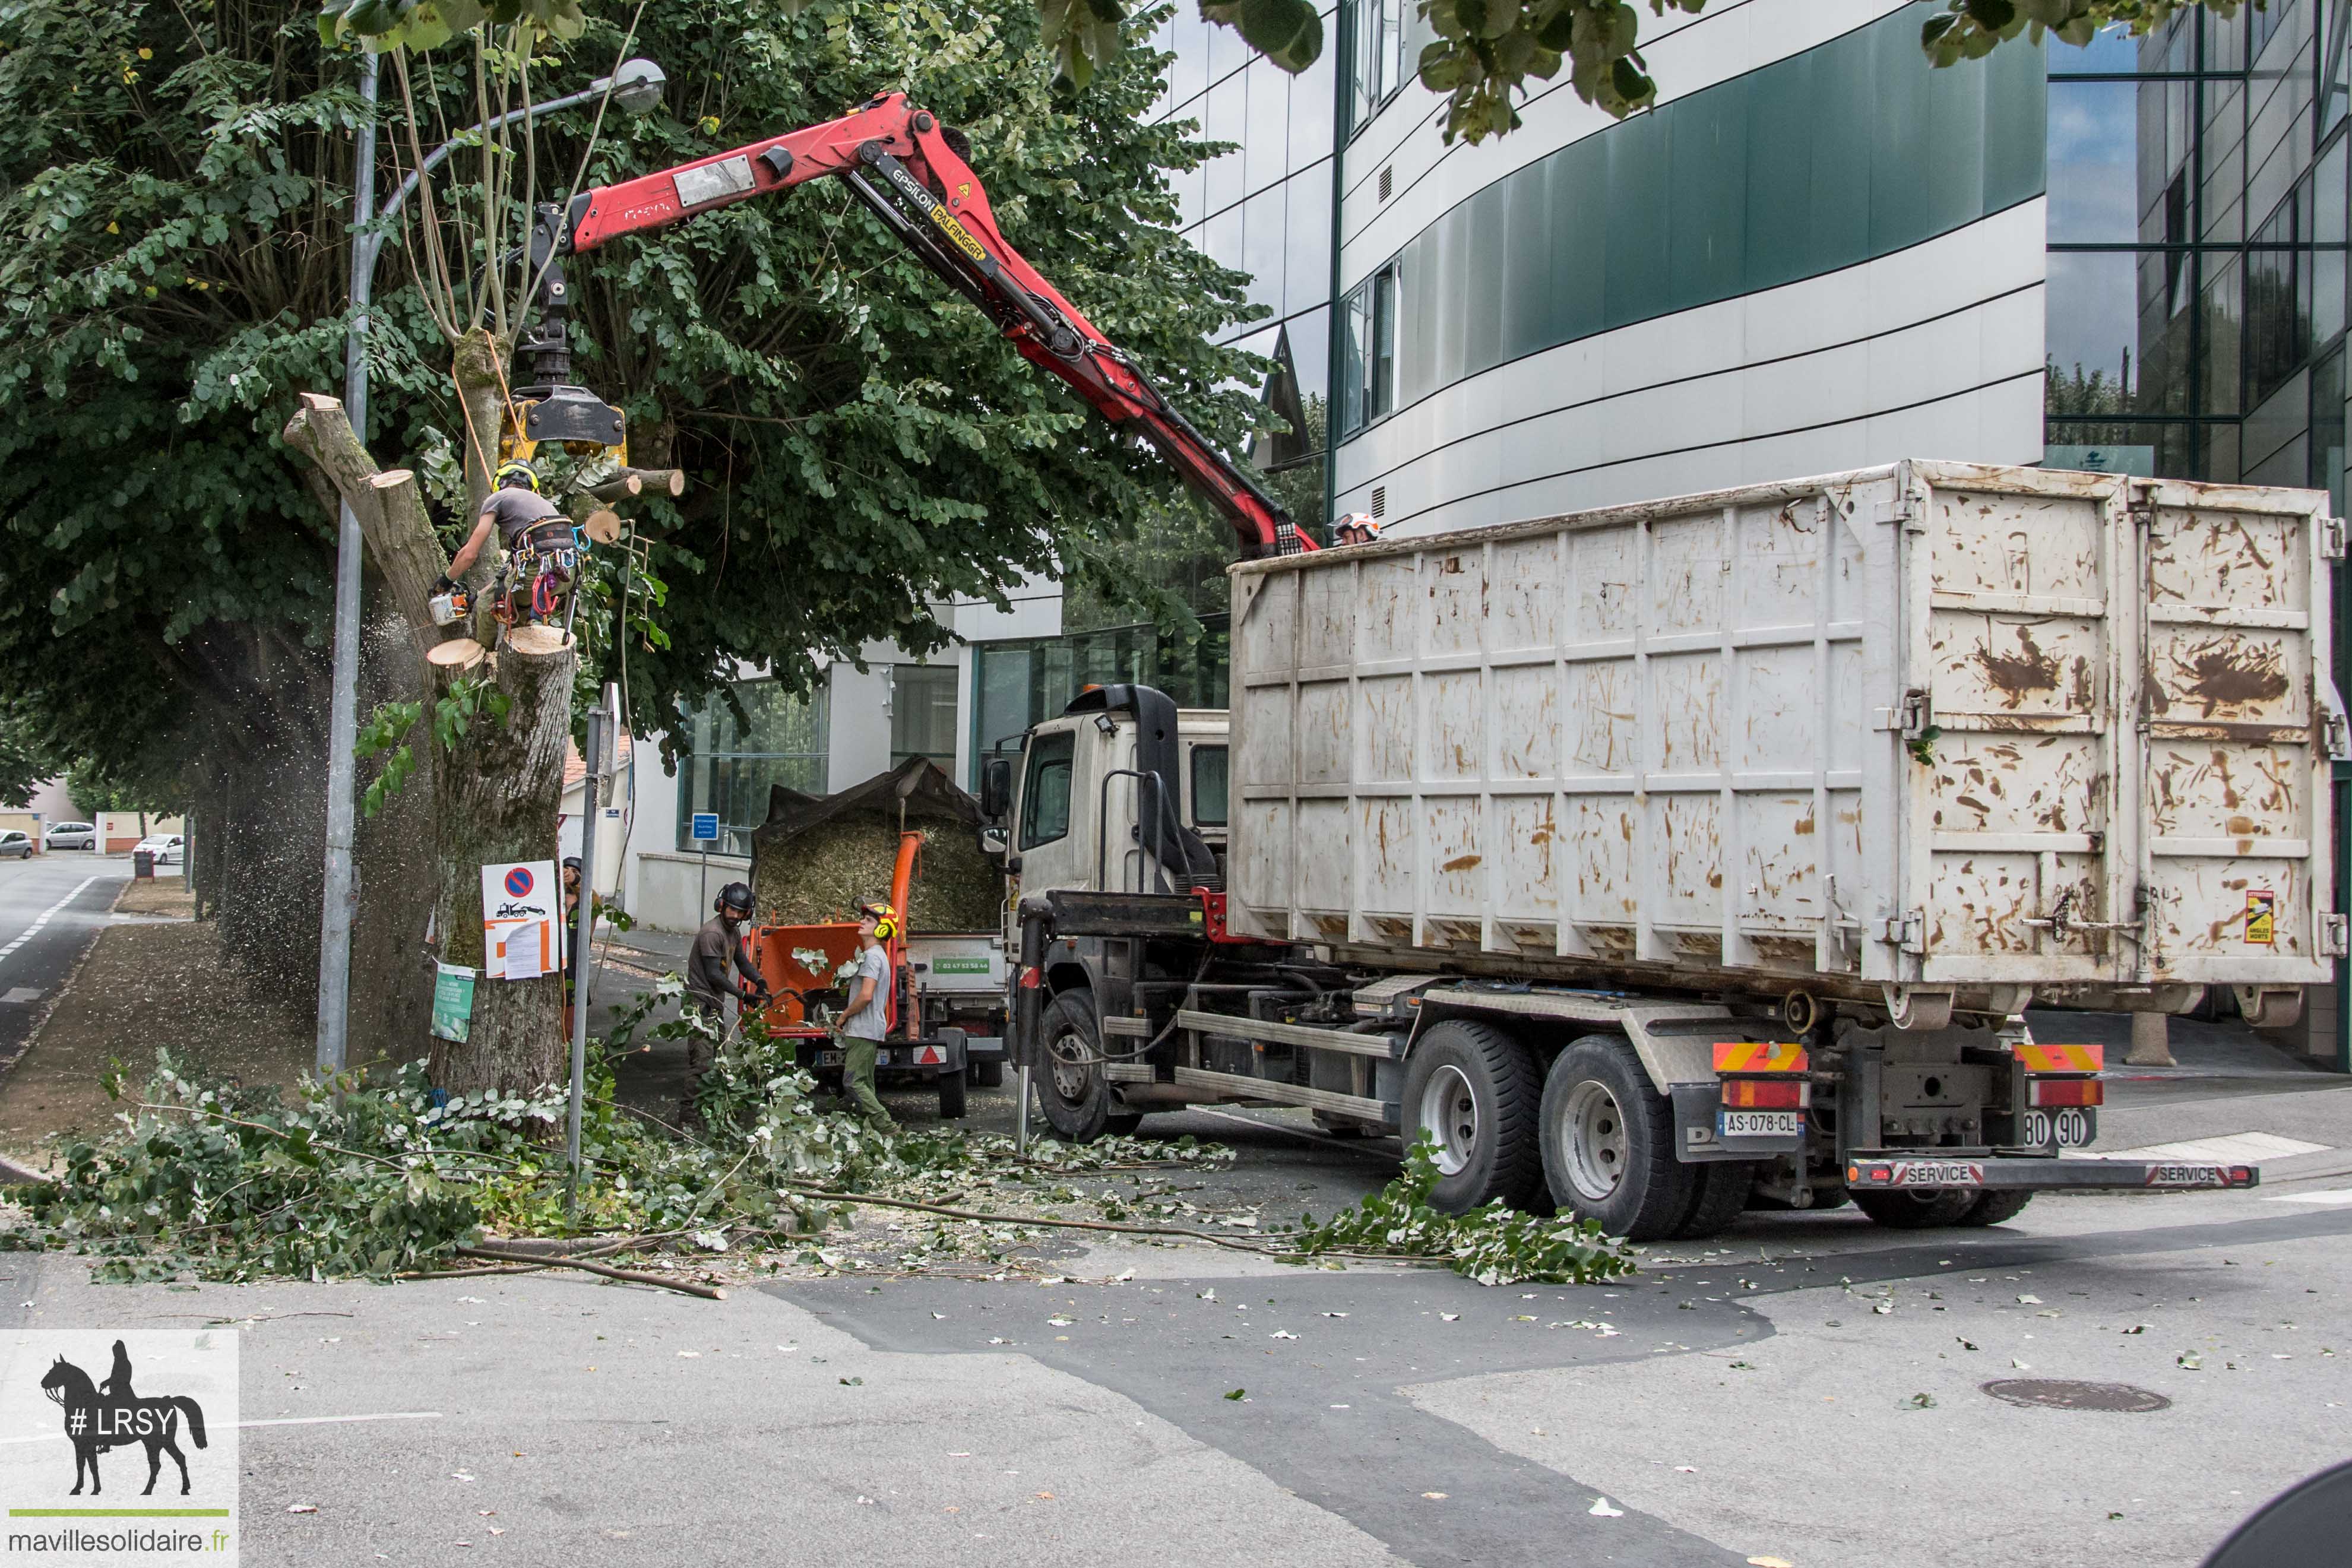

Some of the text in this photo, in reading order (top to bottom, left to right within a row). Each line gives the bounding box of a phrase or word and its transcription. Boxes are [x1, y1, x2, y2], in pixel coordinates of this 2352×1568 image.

[893, 170, 935, 211] EPSILON
[1728, 1114, 1795, 1132] AS-078-CL
[2024, 1114, 2044, 1145] 80
[2059, 1113, 2081, 1144] 90
[1908, 1166, 1968, 1183] SERVICE
[2160, 1167, 2215, 1181] SERVICE
